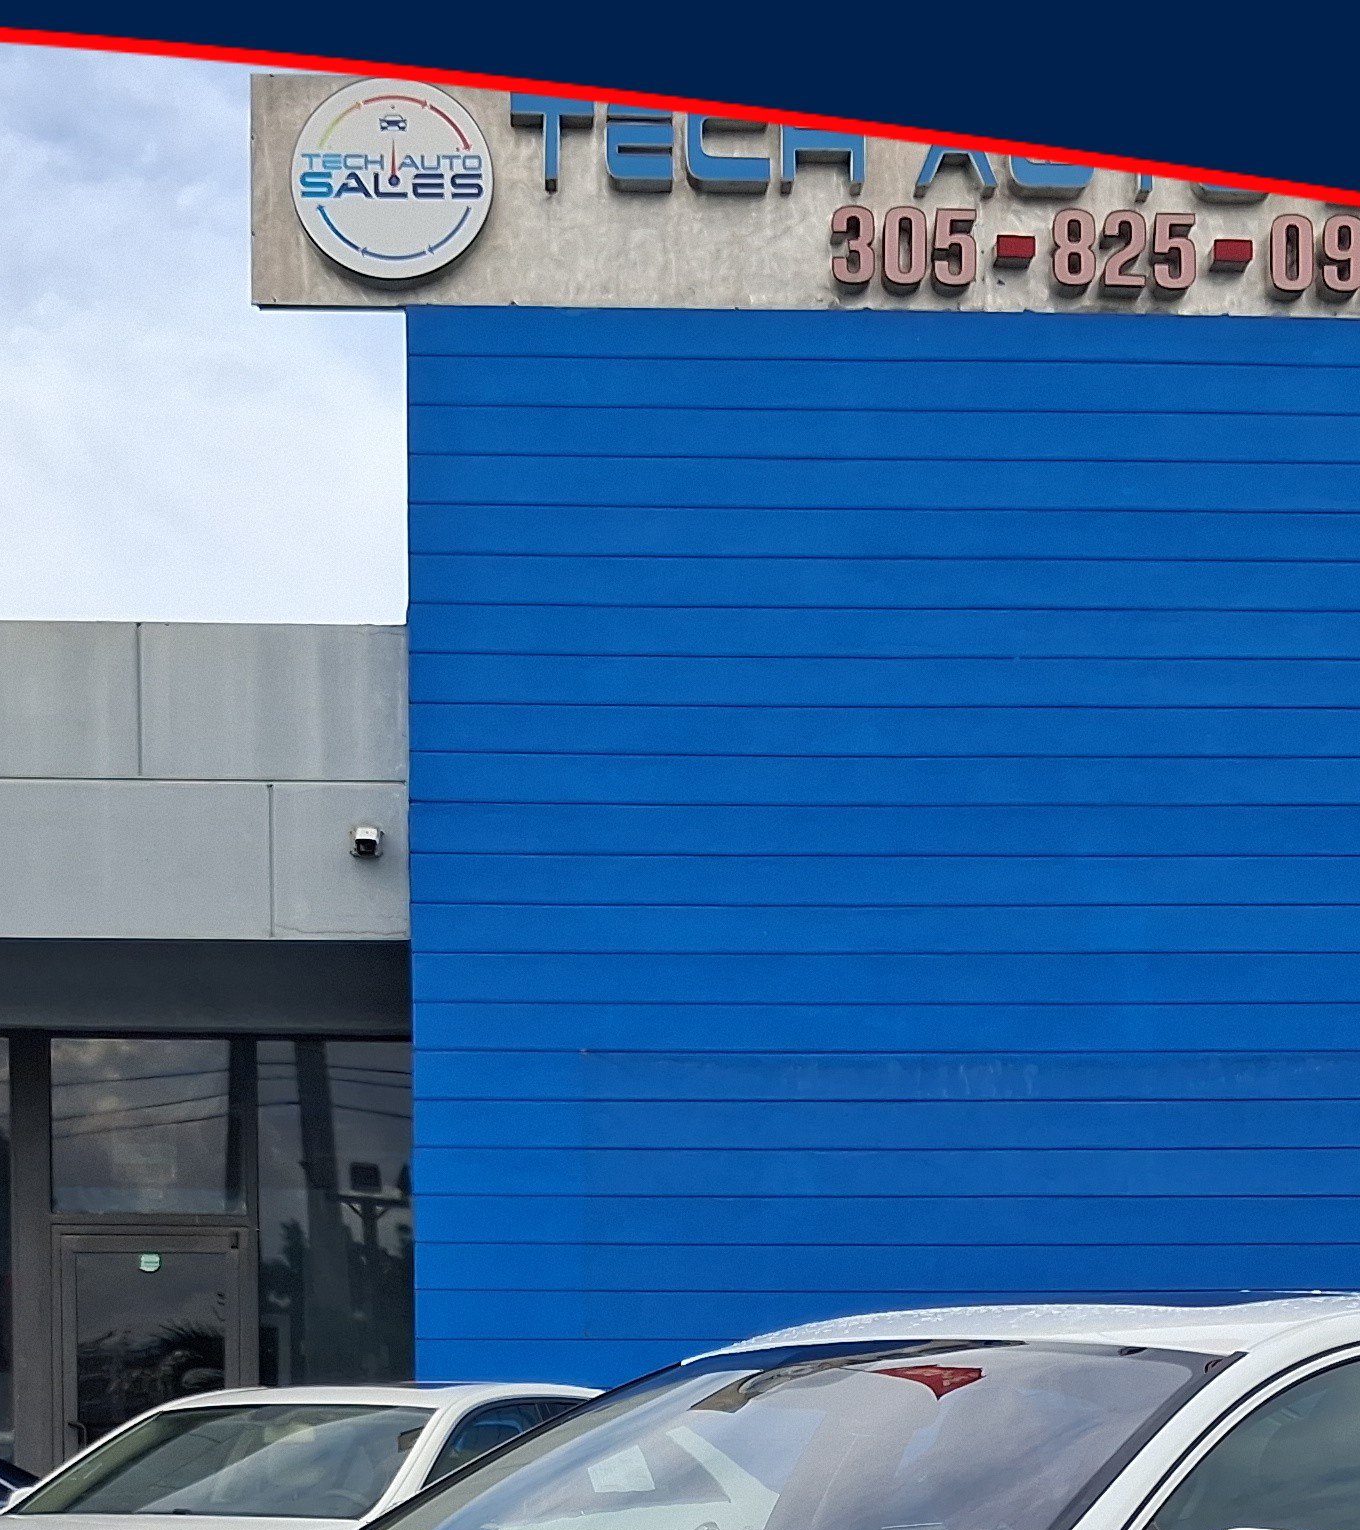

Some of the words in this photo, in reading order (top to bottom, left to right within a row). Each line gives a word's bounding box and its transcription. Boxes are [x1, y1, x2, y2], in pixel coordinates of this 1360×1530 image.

[510, 91, 866, 195] TECH
[301, 152, 385, 172] TECH
[398, 153, 483, 172] AUTO
[299, 171, 485, 200] SALES
